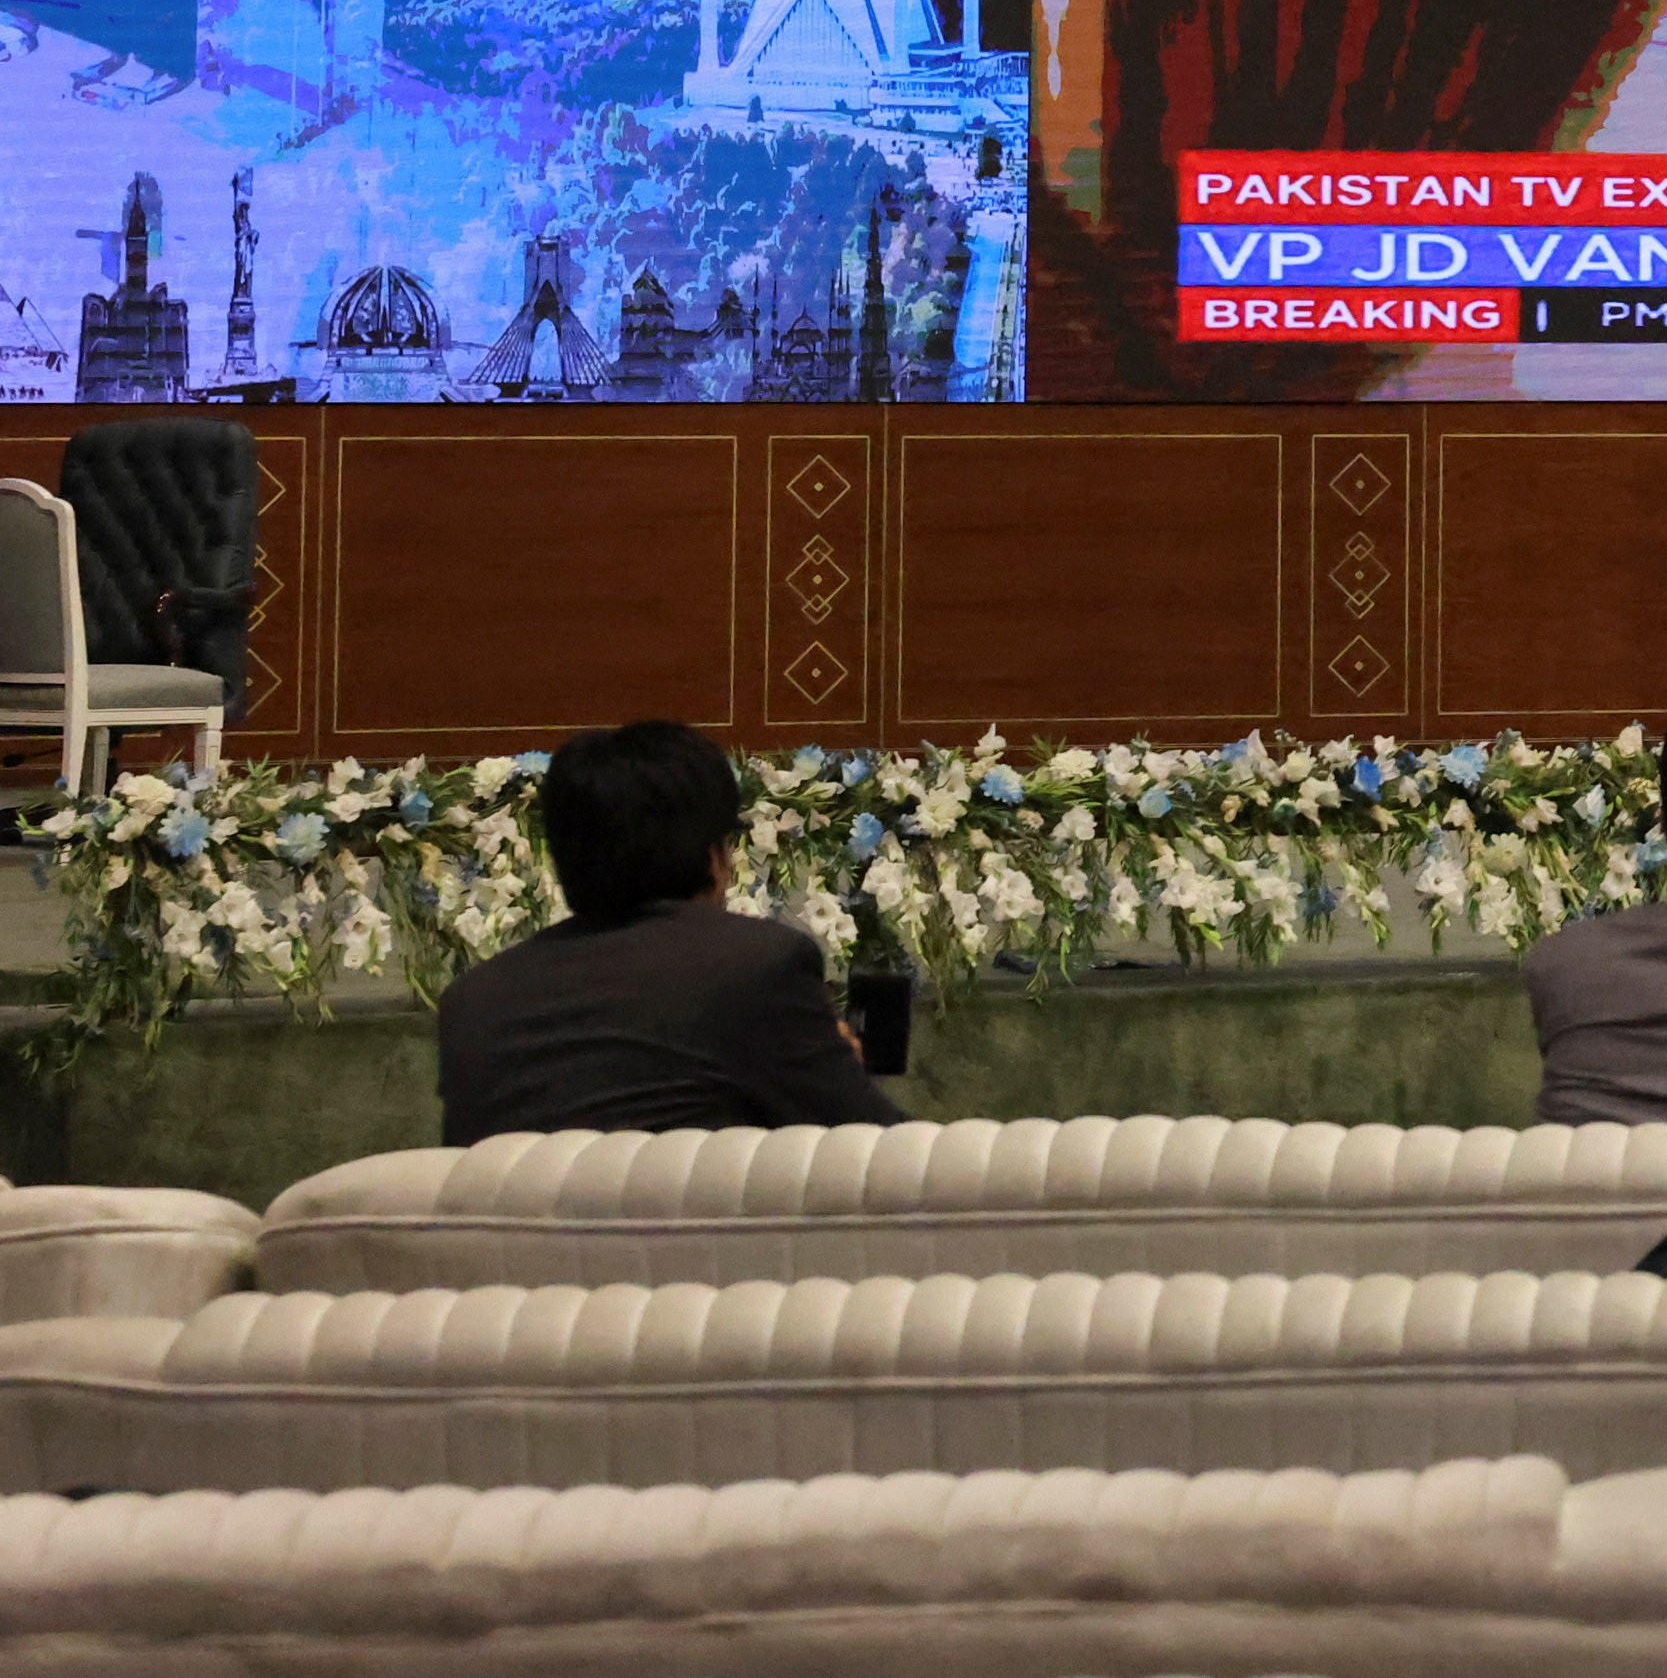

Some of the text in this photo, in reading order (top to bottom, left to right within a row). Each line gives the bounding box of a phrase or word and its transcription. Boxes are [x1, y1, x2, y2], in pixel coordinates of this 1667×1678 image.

[1198, 175, 1491, 208] PAKISTAN
[1511, 177, 1584, 209] TV
[1197, 232, 1325, 281] VP
[1351, 233, 1470, 282] JD
[1205, 300, 1501, 330] BREAKING
